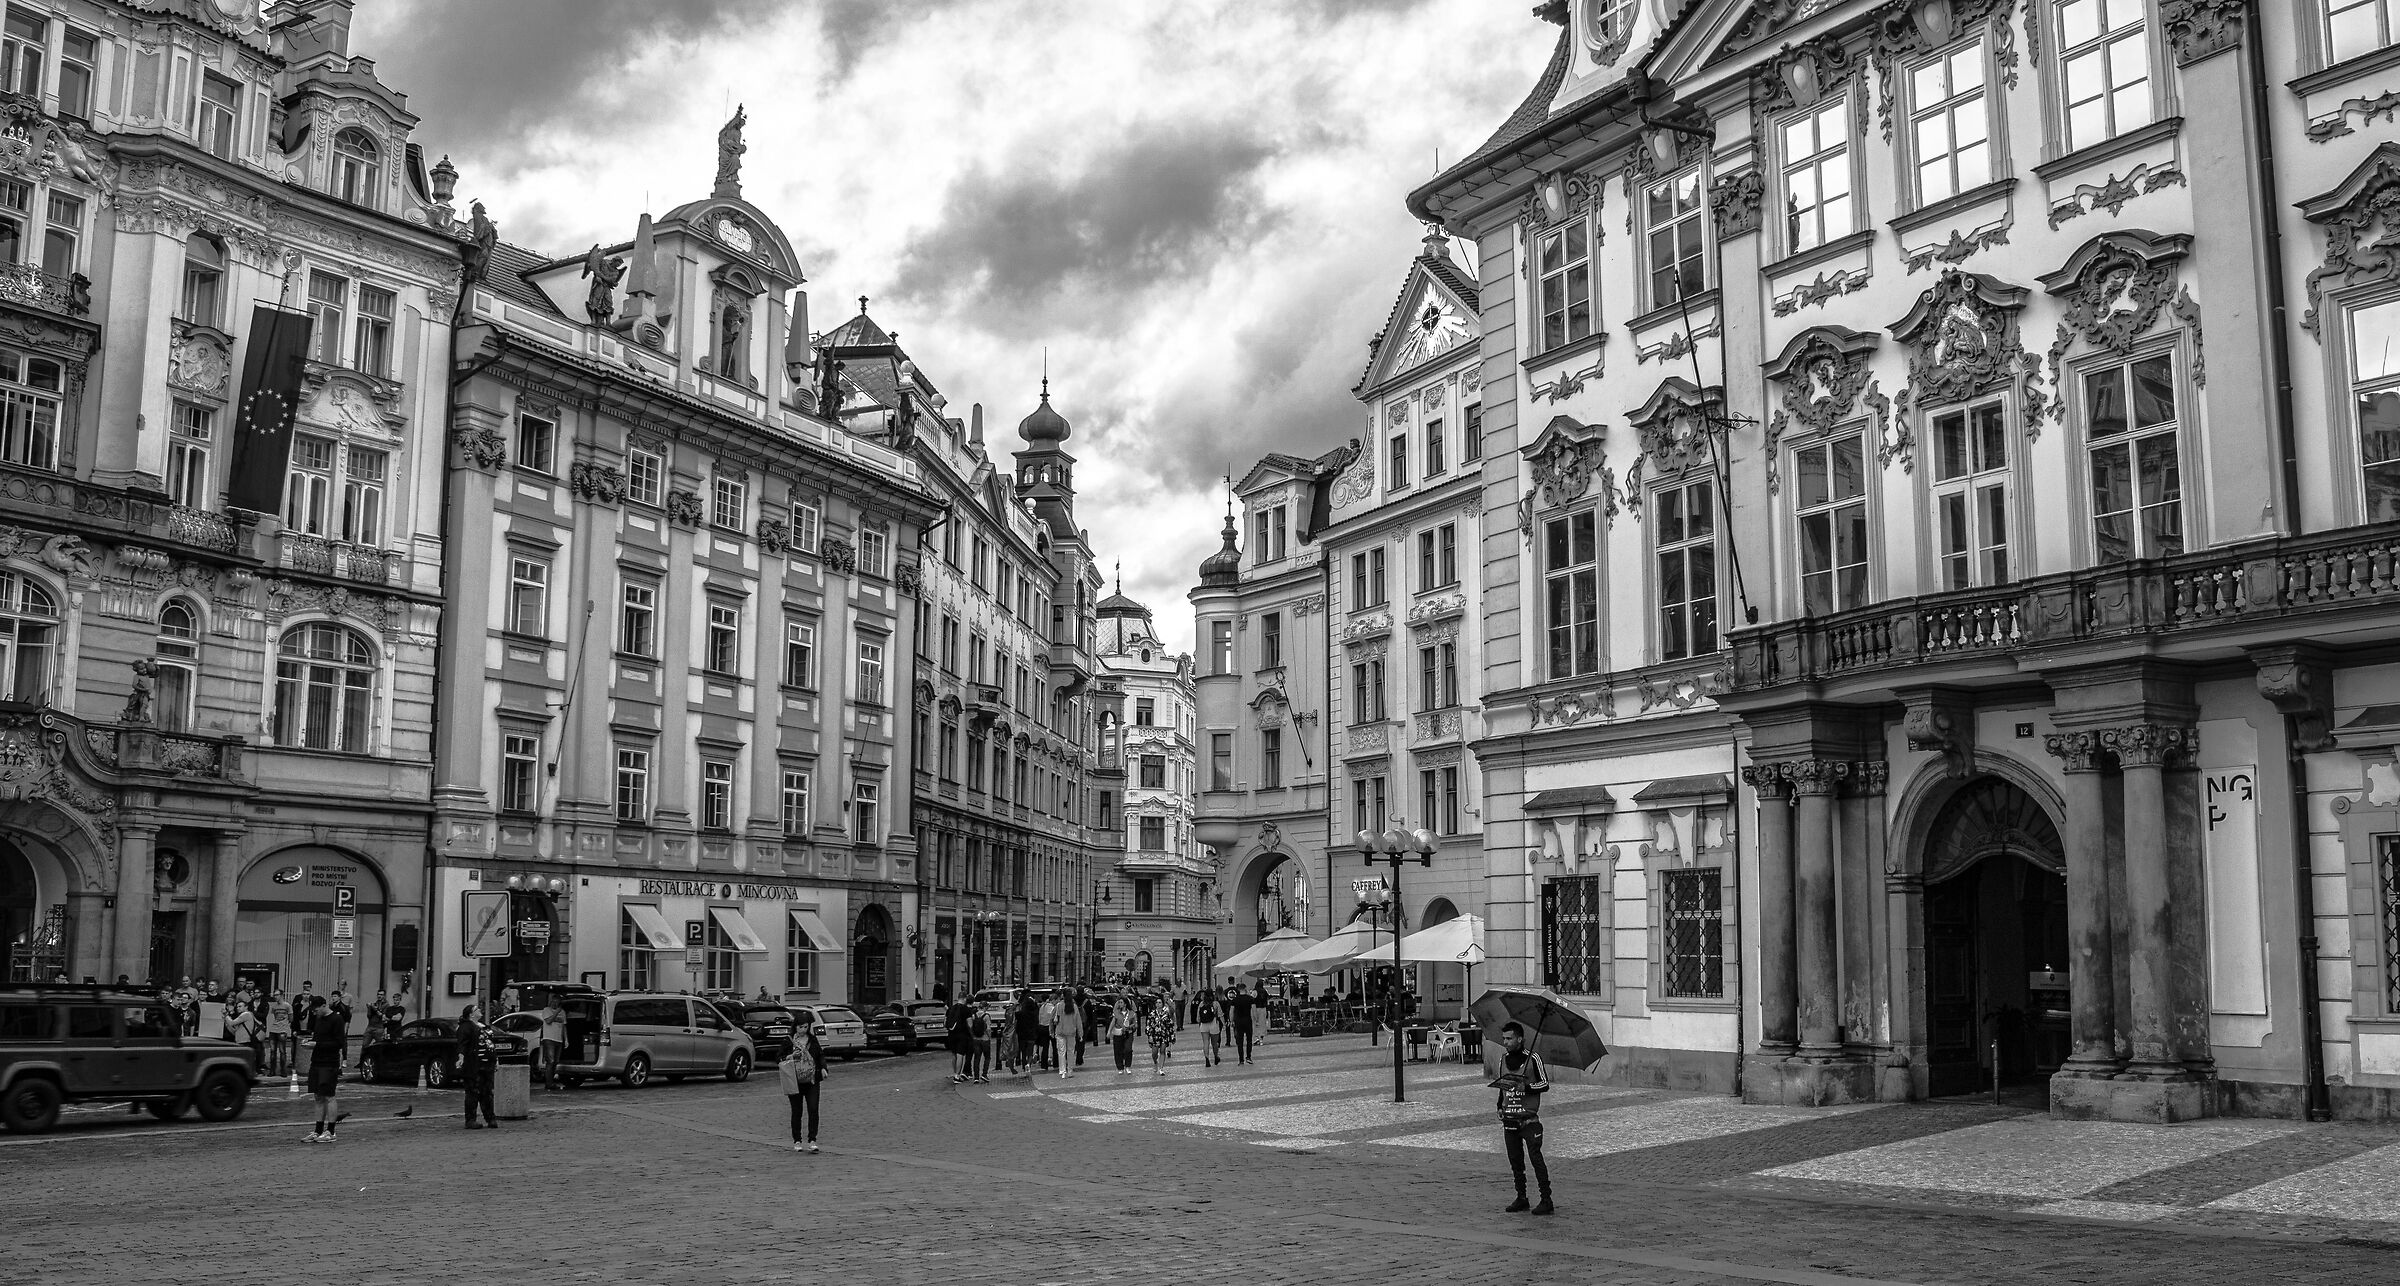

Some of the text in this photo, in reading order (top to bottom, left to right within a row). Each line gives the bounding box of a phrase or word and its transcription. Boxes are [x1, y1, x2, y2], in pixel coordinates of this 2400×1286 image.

[2020, 726, 2029, 735] 12
[2207, 774, 2252, 803] NG
[312, 865, 357, 873] MINISTERSTVO
[640, 879, 799, 900] RESTAURACE MINCOVNA
[338, 889, 352, 908] P
[690, 923, 701, 939] P
